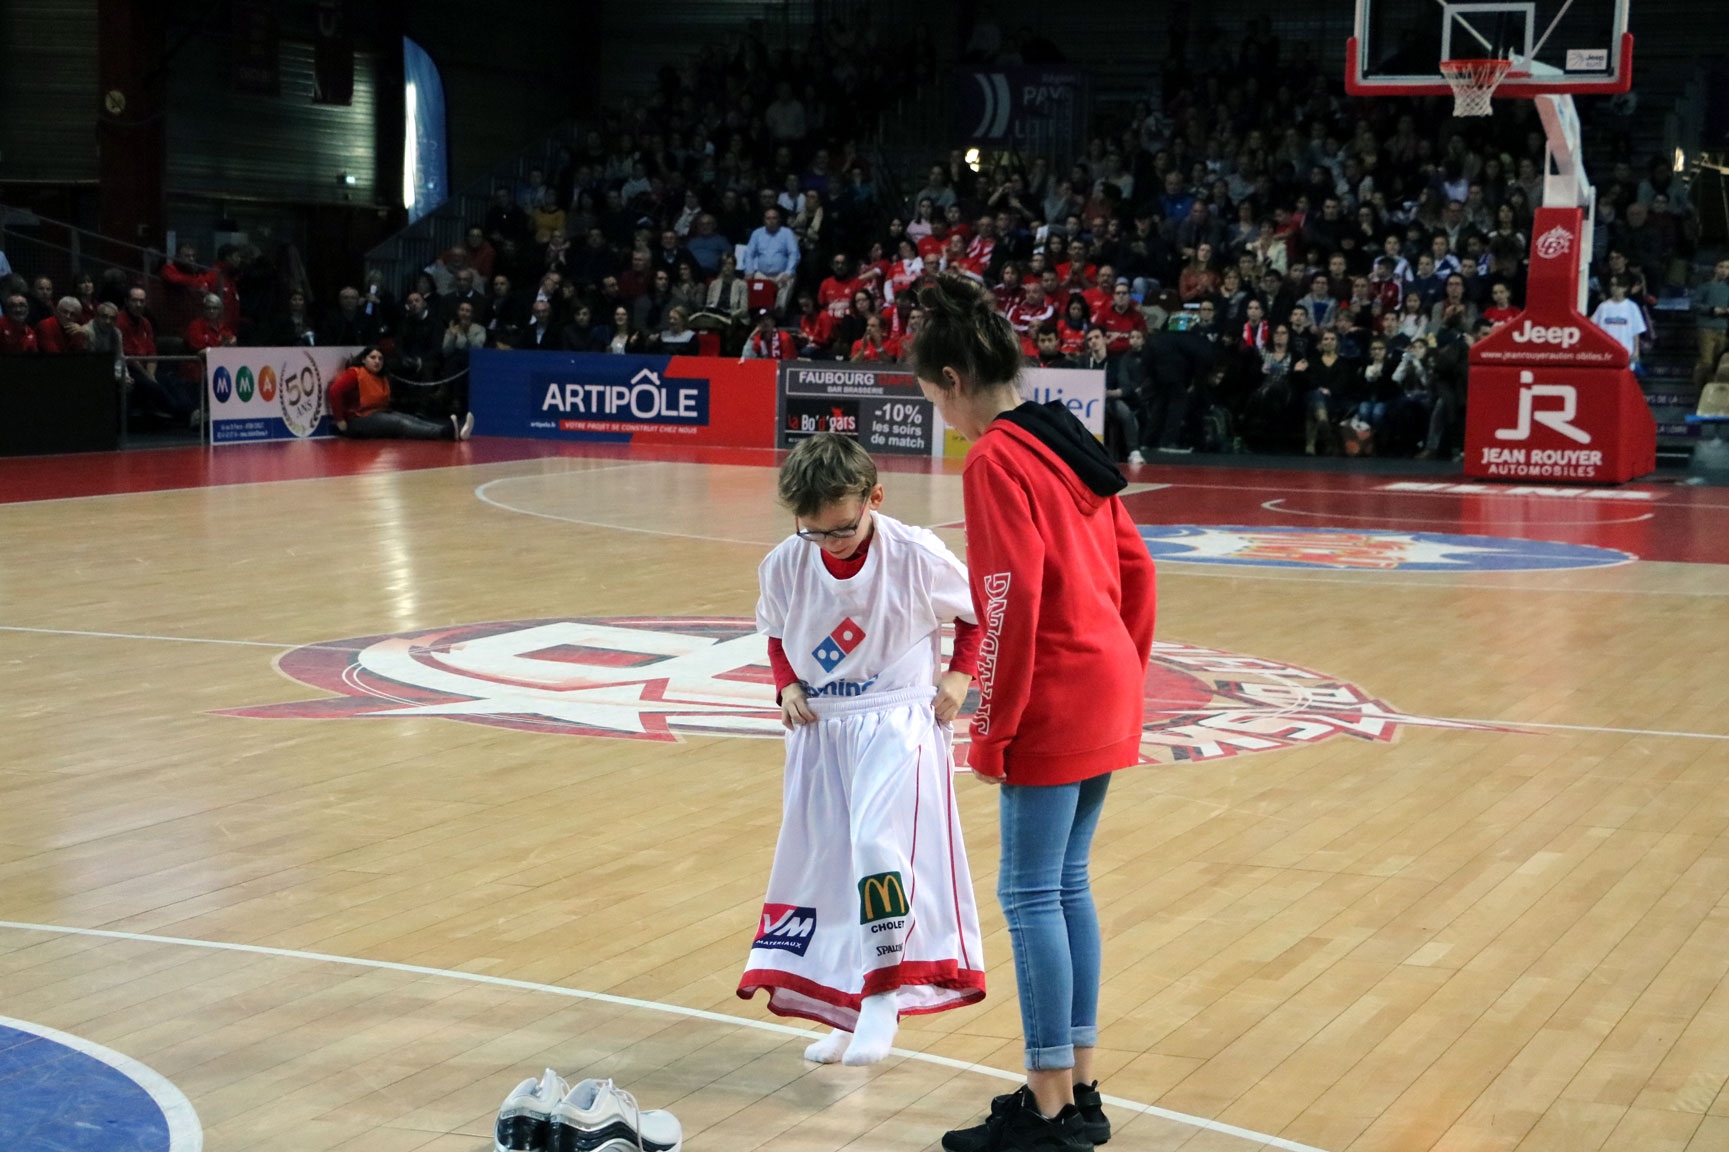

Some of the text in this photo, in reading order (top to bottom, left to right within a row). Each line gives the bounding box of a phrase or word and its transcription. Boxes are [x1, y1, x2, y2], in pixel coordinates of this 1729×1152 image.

[1512, 320, 1580, 348] Jeep
[285, 367, 314, 406] 50
[799, 371, 874, 386] FAUBOURG
[542, 368, 698, 419] ARTIPÔLE
[843, 386, 884, 395] BRASSERIE
[296, 400, 313, 418] ANS
[875, 403, 923, 424] -10%
[621, 424, 657, 433] CONSTRUIT
[872, 421, 922, 436] les soirs
[871, 433, 925, 449] de match
[1481, 448, 1602, 465] JEAN ROUYER
[1488, 464, 1595, 477] AUTOMOBILES
[763, 909, 815, 938] VM
[871, 920, 905, 934] CHOLET
